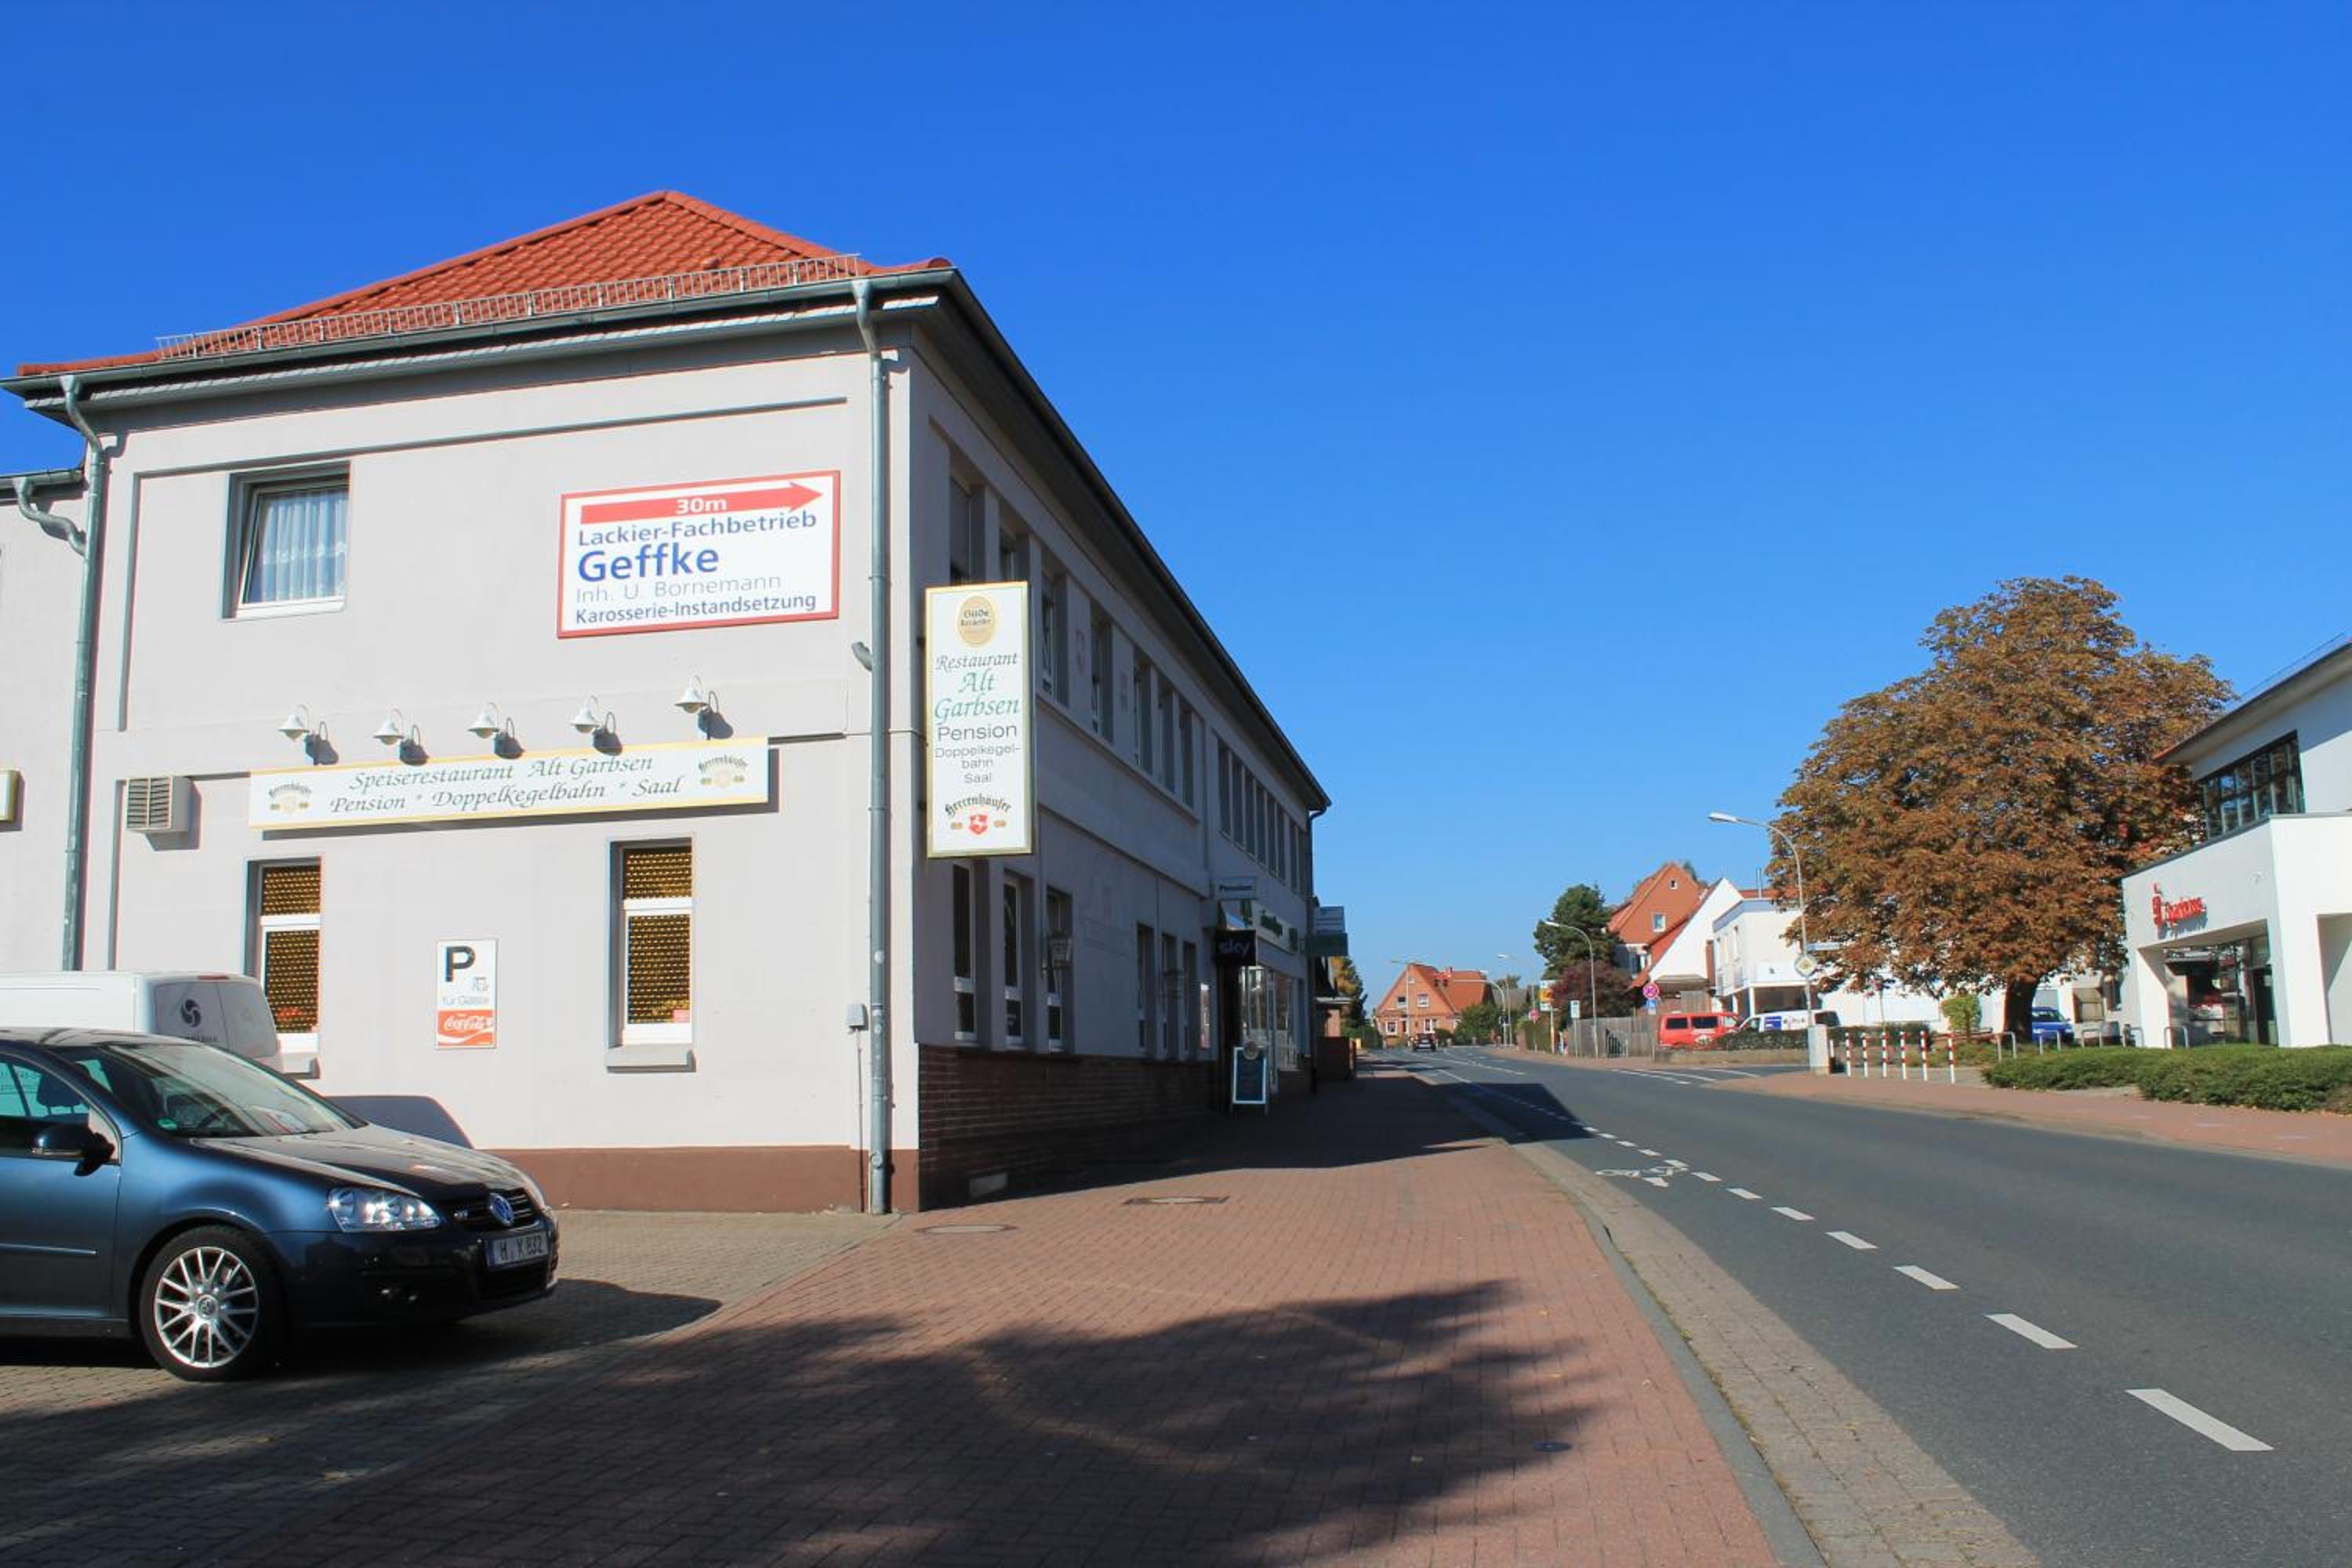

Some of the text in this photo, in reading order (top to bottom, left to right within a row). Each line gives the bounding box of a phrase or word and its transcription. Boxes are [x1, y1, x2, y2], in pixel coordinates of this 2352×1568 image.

[675, 498, 727, 514] 30m
[578, 510, 817, 546] Lackier-Fachbetrieb
[578, 542, 720, 583] Geffke
[576, 586, 615, 603] Inh.
[655, 575, 781, 598] Bornemann
[575, 593, 817, 624] Karosserie-Instandsetzung
[935, 652, 1017, 673] Restaurant
[958, 668, 996, 692] Alt
[935, 692, 1019, 725] Garbsen
[938, 724, 1017, 741] Pension
[935, 743, 1022, 758] Doppelkegel-
[961, 758, 993, 769] bahn
[349, 755, 652, 794] Speiserestaurant Alt Garbsen
[964, 772, 992, 784] Saal
[329, 775, 685, 813] Pension Doppelkegelbahn Saal
[1219, 938, 1250, 956] sky
[445, 946, 475, 982] P
